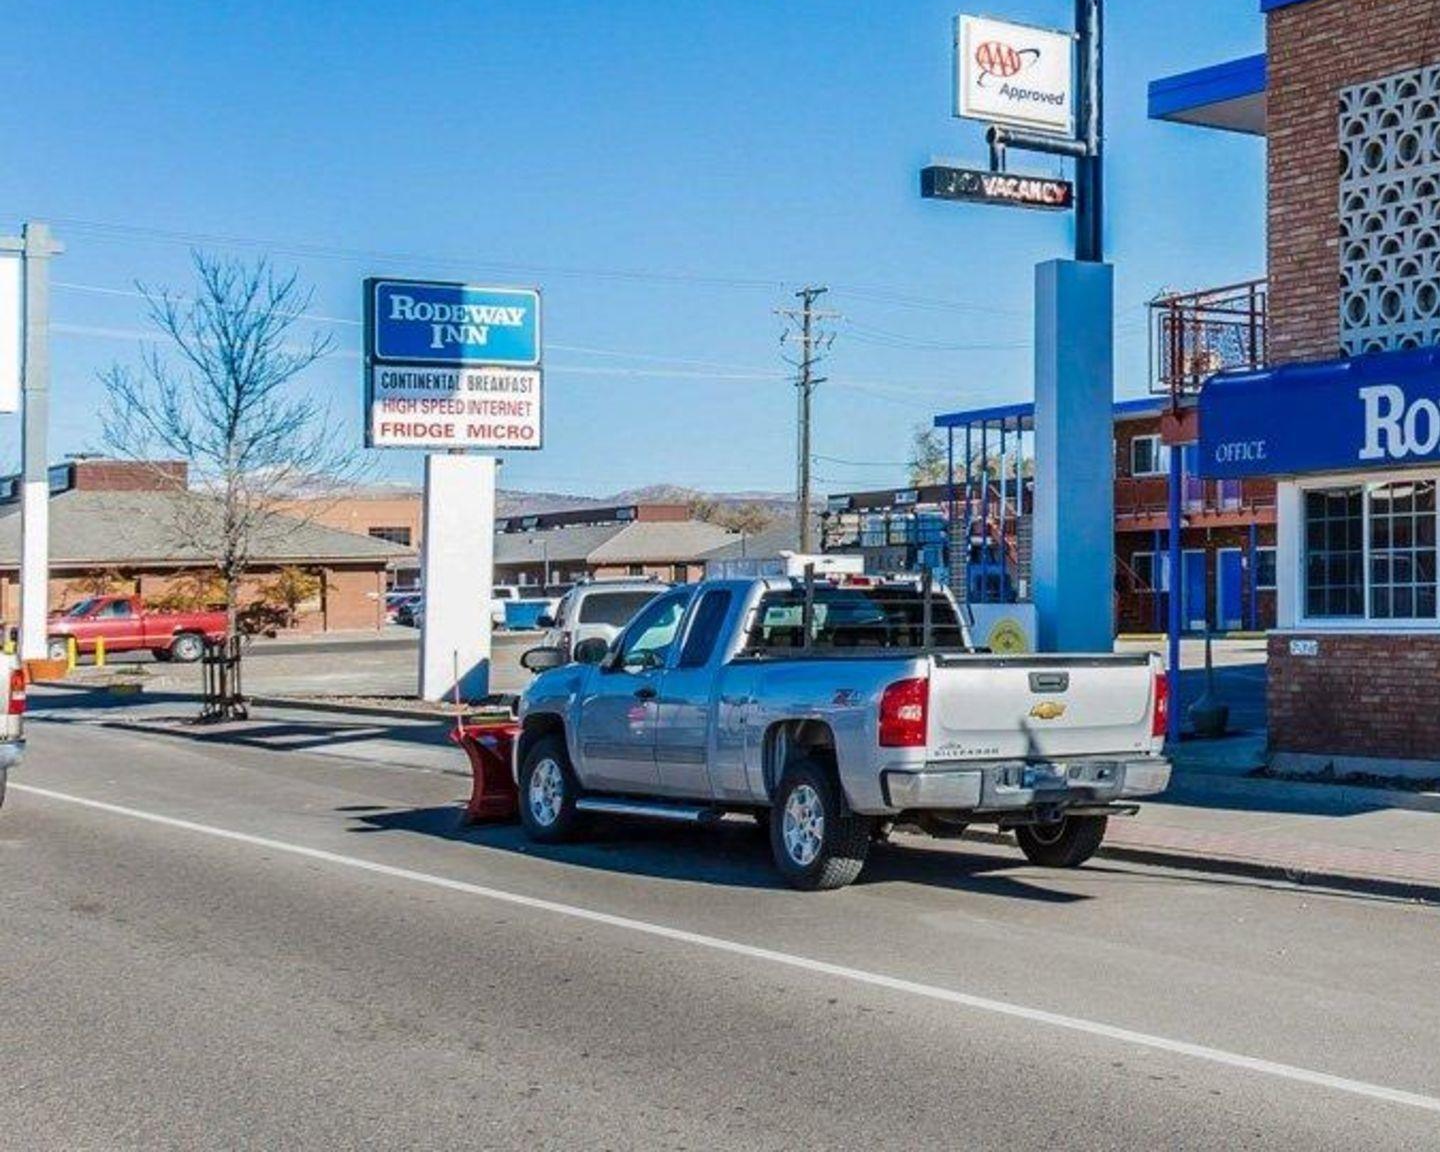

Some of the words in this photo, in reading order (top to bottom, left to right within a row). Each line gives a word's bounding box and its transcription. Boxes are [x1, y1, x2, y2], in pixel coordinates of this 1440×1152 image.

[999, 82, 1066, 106] Approved
[980, 174, 1067, 204] VACANCY
[388, 294, 527, 327] RODEWAY
[429, 323, 490, 349] INN
[381, 372, 462, 393] CONTINENTAL
[466, 374, 535, 394] BREAKFAST
[383, 397, 418, 414] HIGH
[421, 398, 466, 415] SPEED
[467, 399, 532, 418] INTERNET
[381, 423, 455, 439] FRIDGE
[466, 424, 535, 440] MICRO
[1215, 439, 1267, 463] OFFICE
